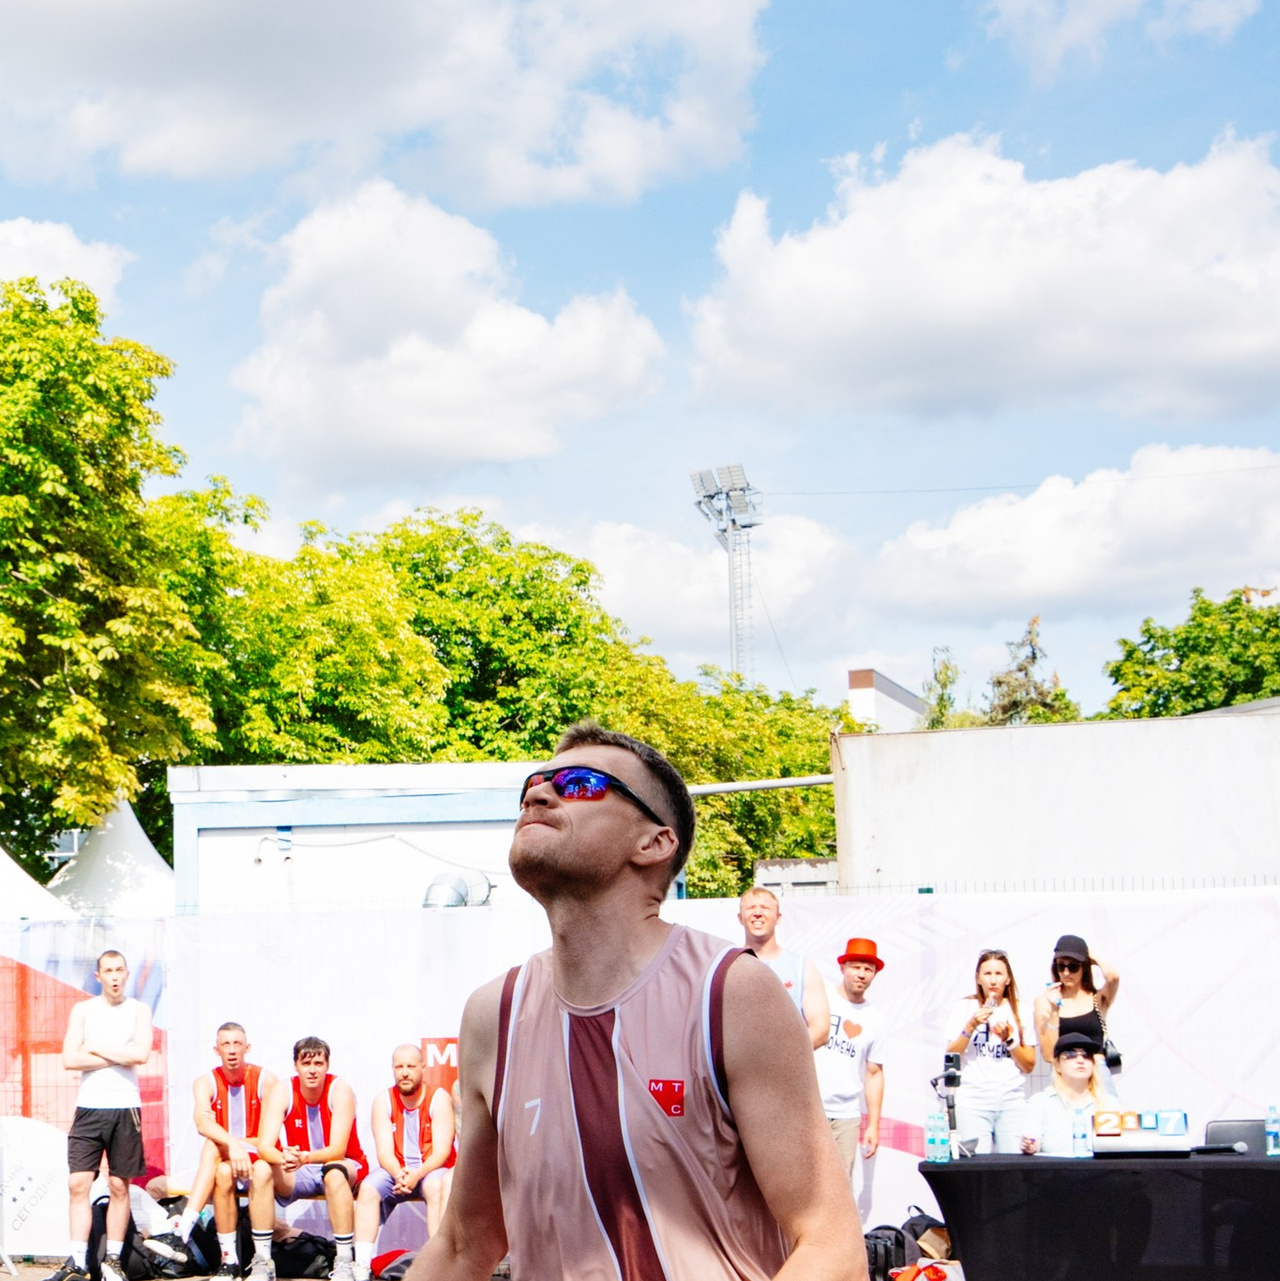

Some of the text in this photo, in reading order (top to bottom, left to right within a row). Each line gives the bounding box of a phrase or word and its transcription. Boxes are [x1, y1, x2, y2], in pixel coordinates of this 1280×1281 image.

[524, 1098, 541, 1136] 7
[1097, 1112, 1121, 1134] 2
[1160, 1112, 1182, 1134] 7
[11, 1170, 56, 1231] СЕГОДНЯ
